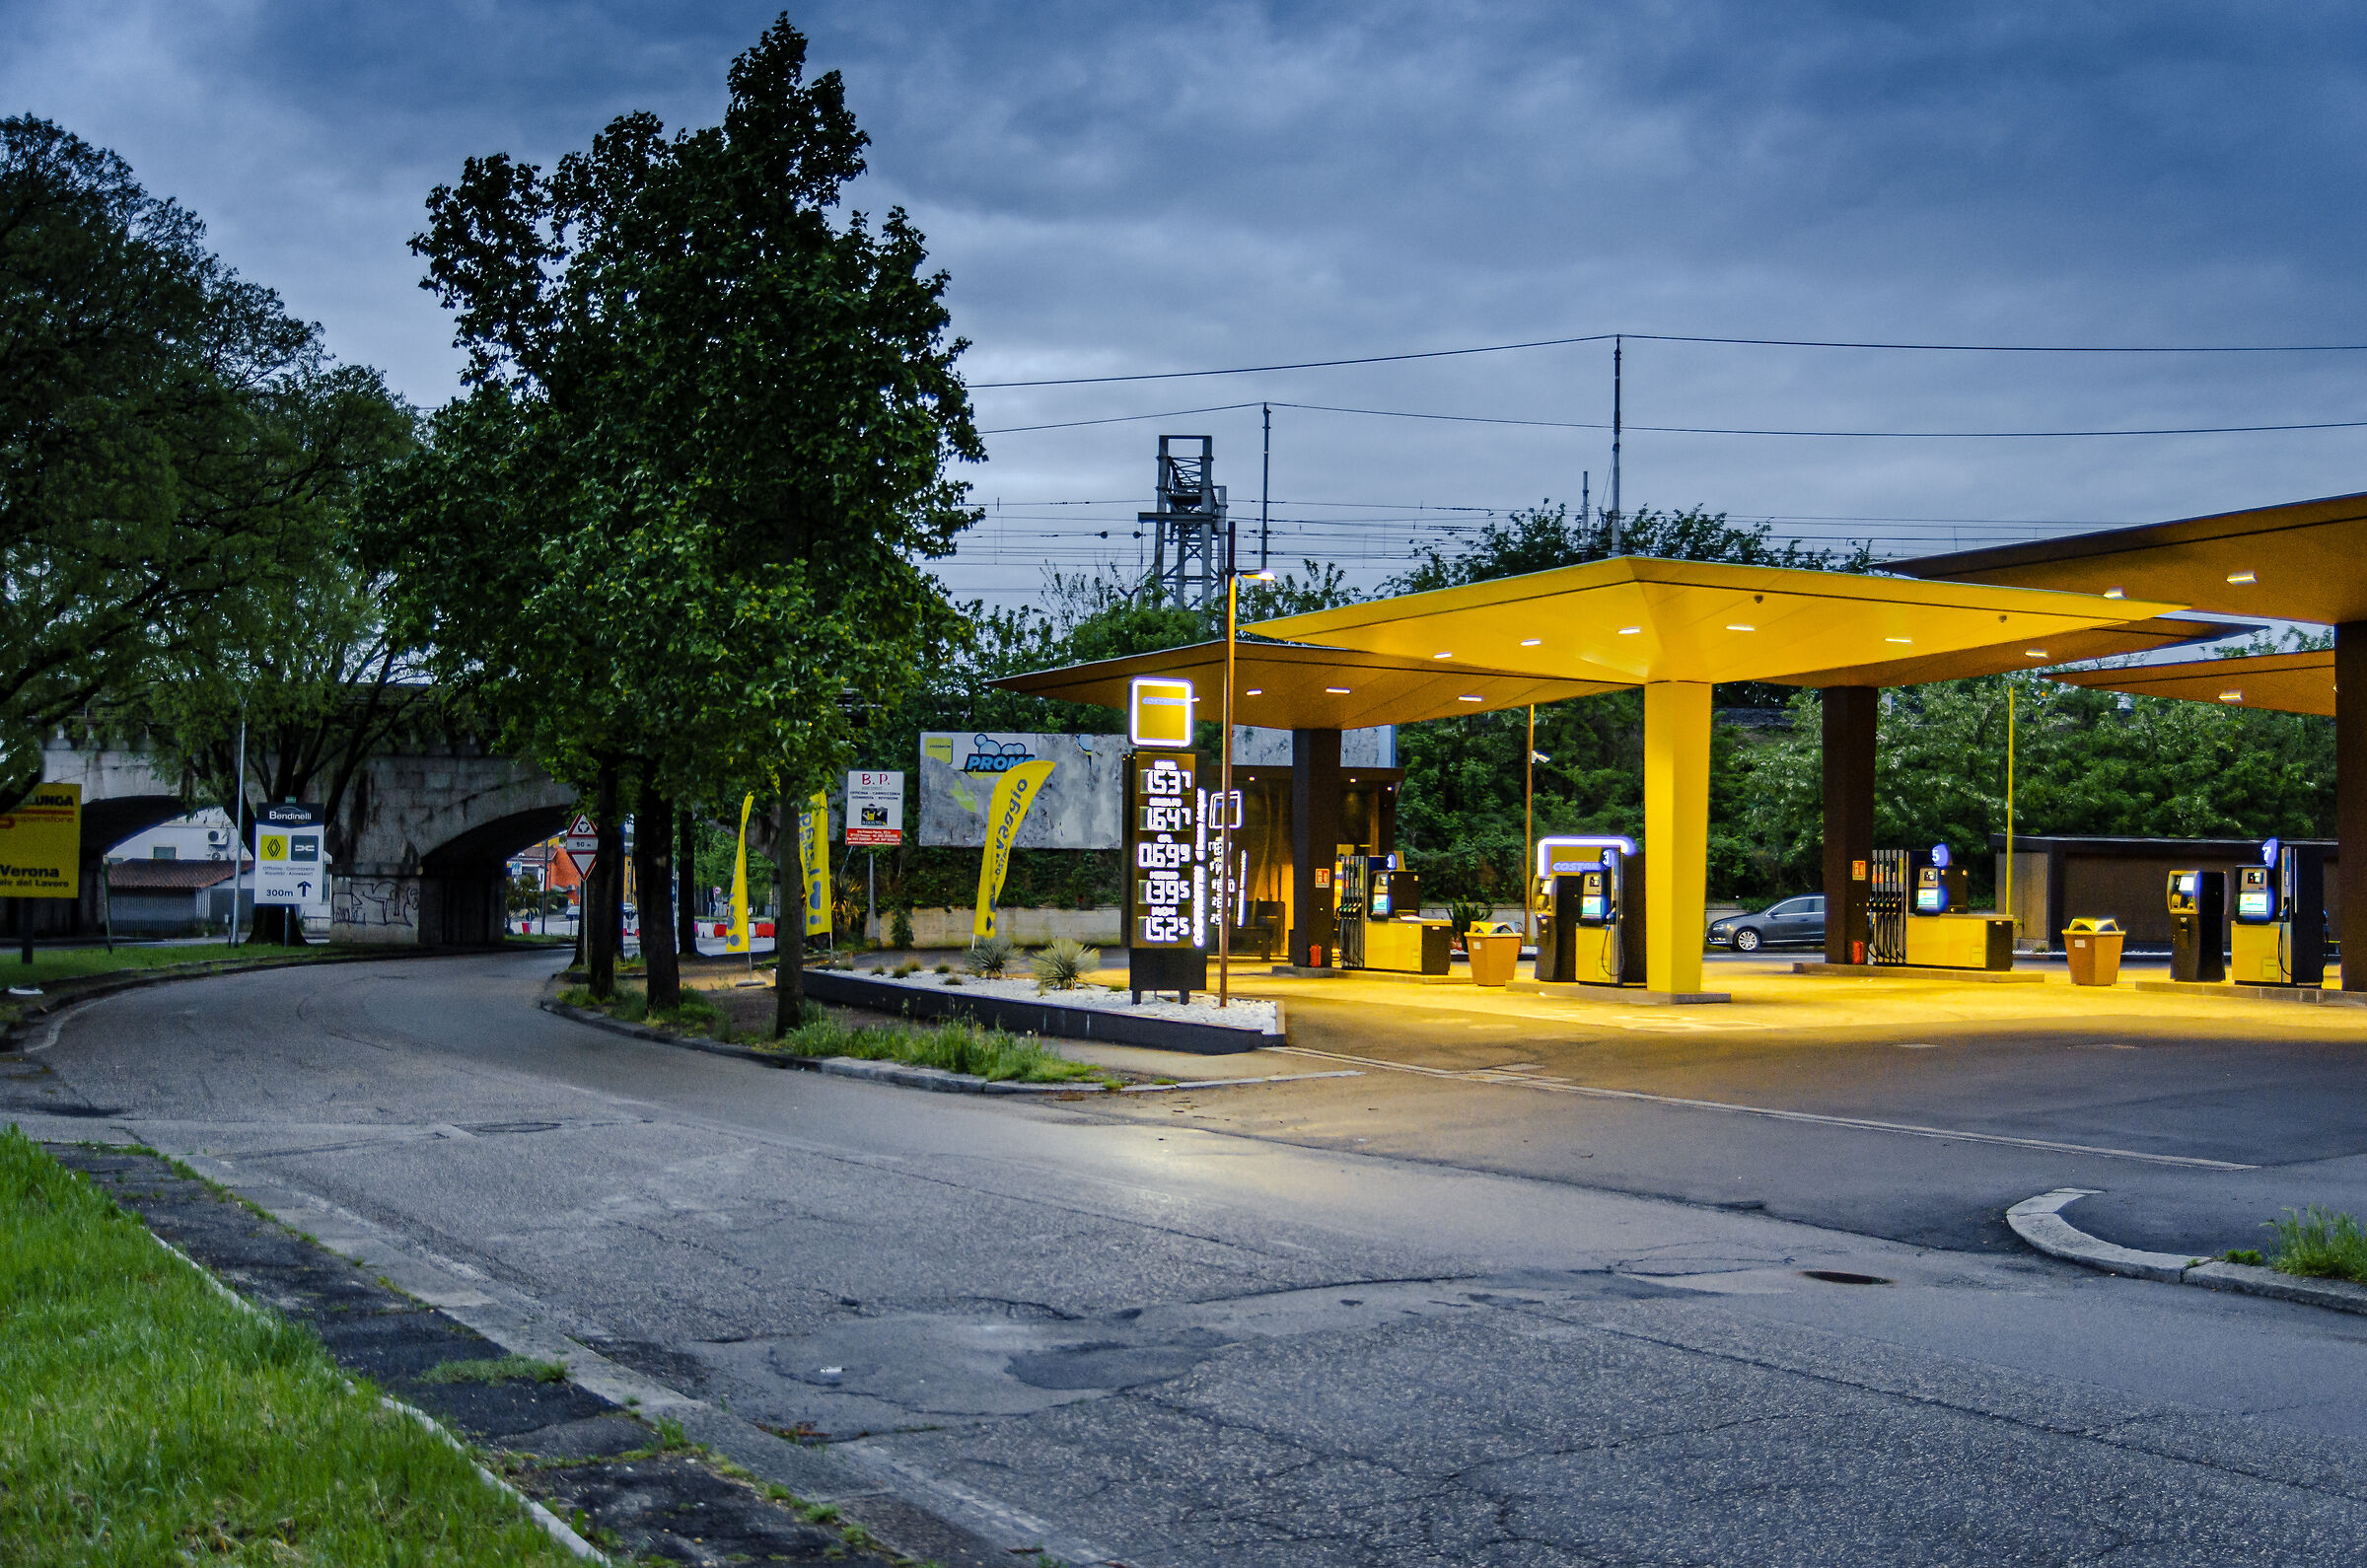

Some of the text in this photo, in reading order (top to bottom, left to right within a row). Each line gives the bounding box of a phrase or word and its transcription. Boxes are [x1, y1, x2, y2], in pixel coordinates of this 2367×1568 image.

[269, 810, 312, 820] Bendinelli
[995, 778, 1028, 864] vaggio
[1932, 849, 1940, 862] 5
[0, 864, 59, 878] Verona
